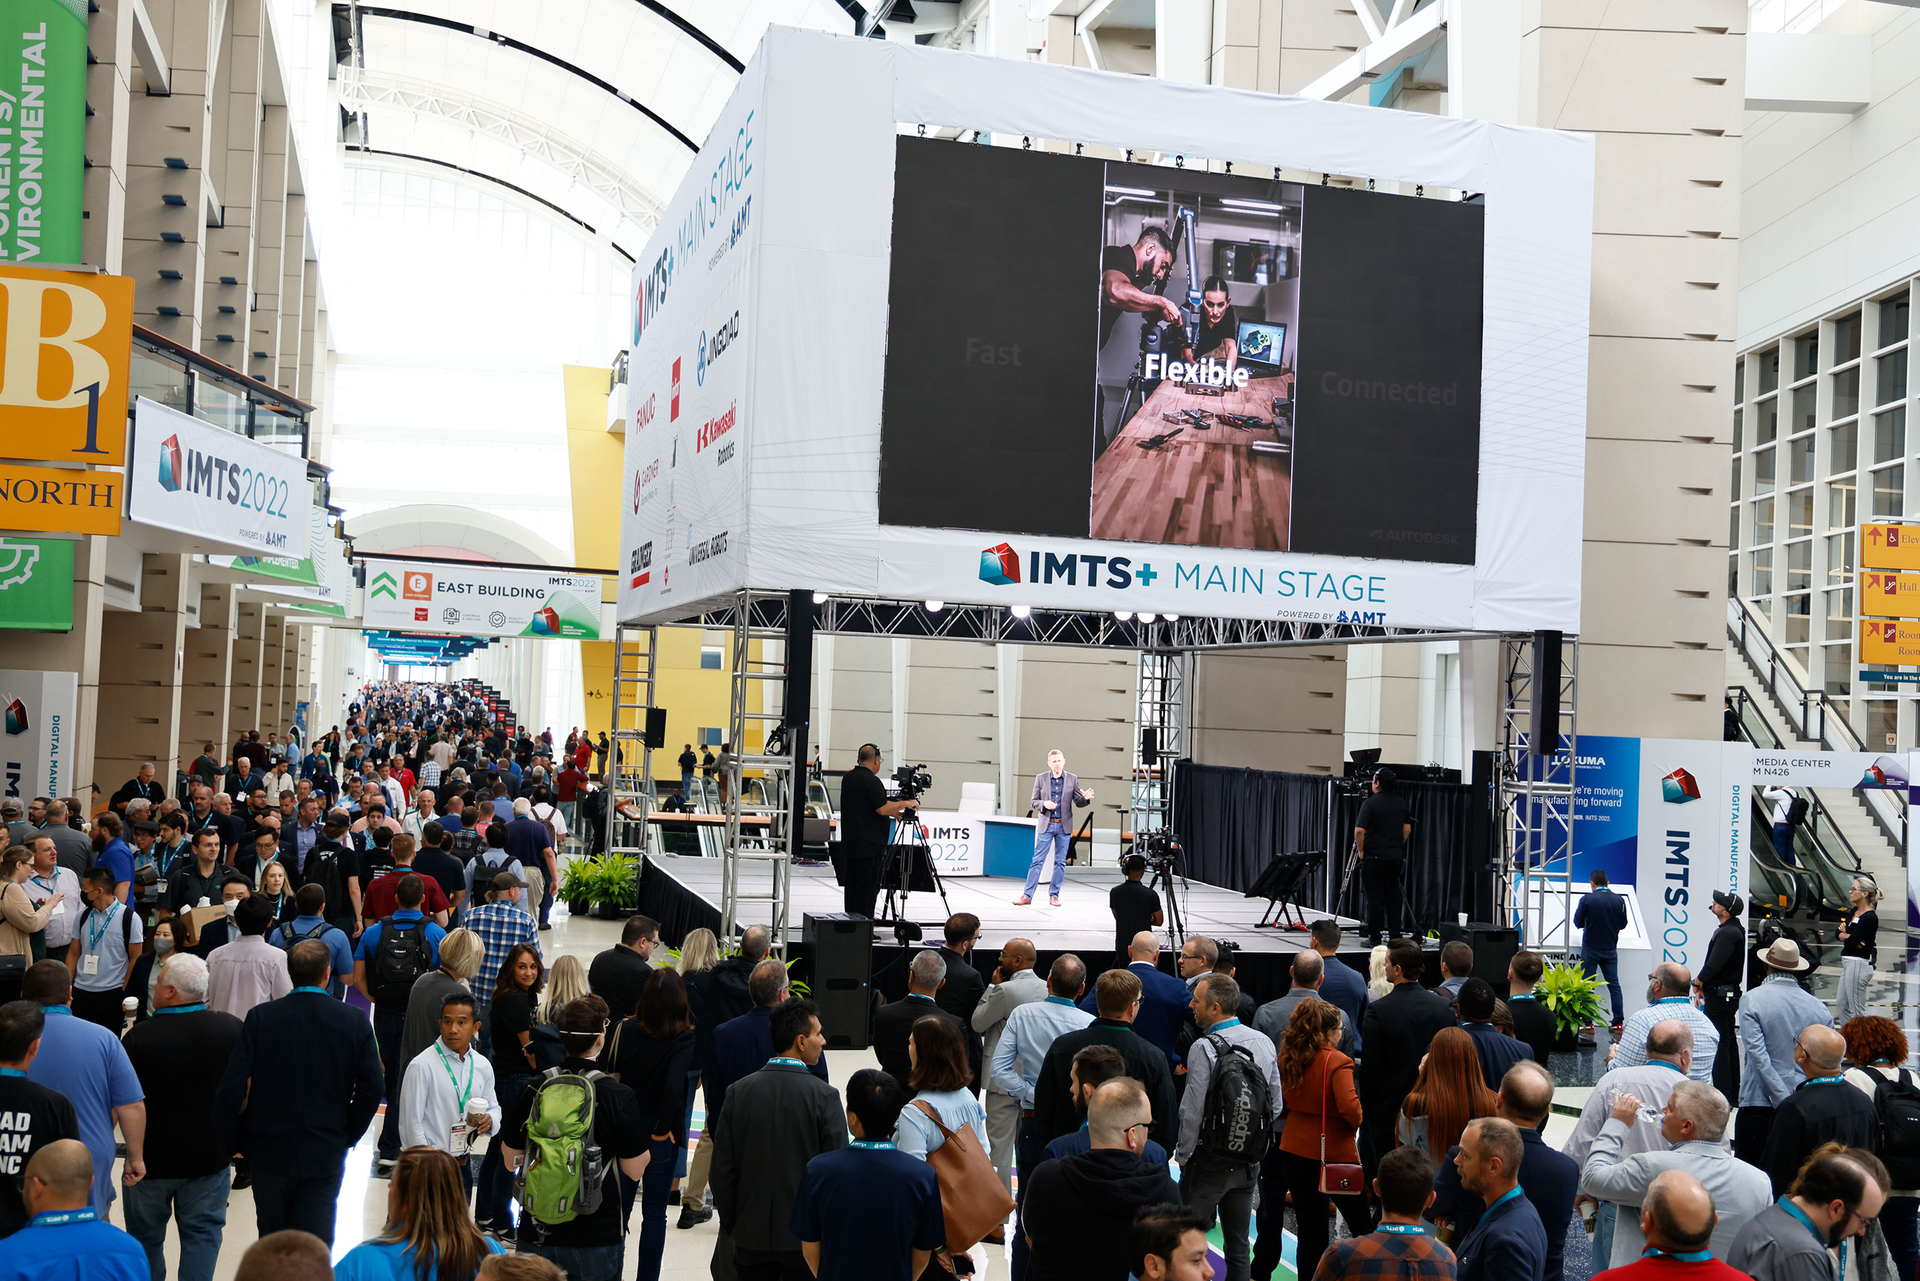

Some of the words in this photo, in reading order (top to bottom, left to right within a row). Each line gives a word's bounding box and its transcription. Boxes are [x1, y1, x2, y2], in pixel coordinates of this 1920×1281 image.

[644, 245, 674, 330] IMTS+
[677, 187, 707, 275] MAIN
[709, 108, 754, 229] STAGE
[736, 194, 752, 242] AMT
[0, 277, 110, 409] B
[707, 309, 740, 366] JINGDIAO
[965, 336, 1021, 366] Fast
[1145, 352, 1249, 388] Flexible
[1320, 371, 1457, 407] Connected
[71, 381, 109, 454] 1
[636, 392, 656, 435] FANUC
[710, 398, 737, 444] Kawasaki
[716, 440, 734, 468] Robotics
[641, 458, 659, 488] GARDNER
[0, 478, 115, 508] NORTH
[239, 529, 259, 540] POWERED
[271, 532, 287, 548] AMT
[689, 538, 710, 566] UNIVERSAL
[710, 531, 728, 558] ROBOTS
[1386, 530, 1459, 545] AUTODESK
[631, 540, 652, 575] GRAINGER
[415, 578, 421, 589] E
[437, 582, 473, 594] EAST
[478, 585, 545, 599] BUILDING
[1030, 551, 1158, 589] IMTS+
[1174, 563, 1264, 594] MAIN
[1276, 570, 1386, 603] STAGE
[1899, 582, 1917, 592] Hall
[1276, 610, 1322, 620] POWERED
[1324, 613, 1334, 621] BY
[1350, 611, 1386, 625] AMT
[50, 715, 60, 757] DIGITAL
[1756, 758, 1788, 767] MEDIA
[1791, 760, 1831, 768] CENTER
[1532, 796, 1588, 808] maufactring
[1590, 798, 1622, 807] forward
[1594, 787, 1624, 798] moving
[1731, 784, 1740, 826] DIGITAL
[933, 827, 970, 840] IMTS
[922, 843, 968, 861] 022
[0, 1111, 31, 1132] AD
